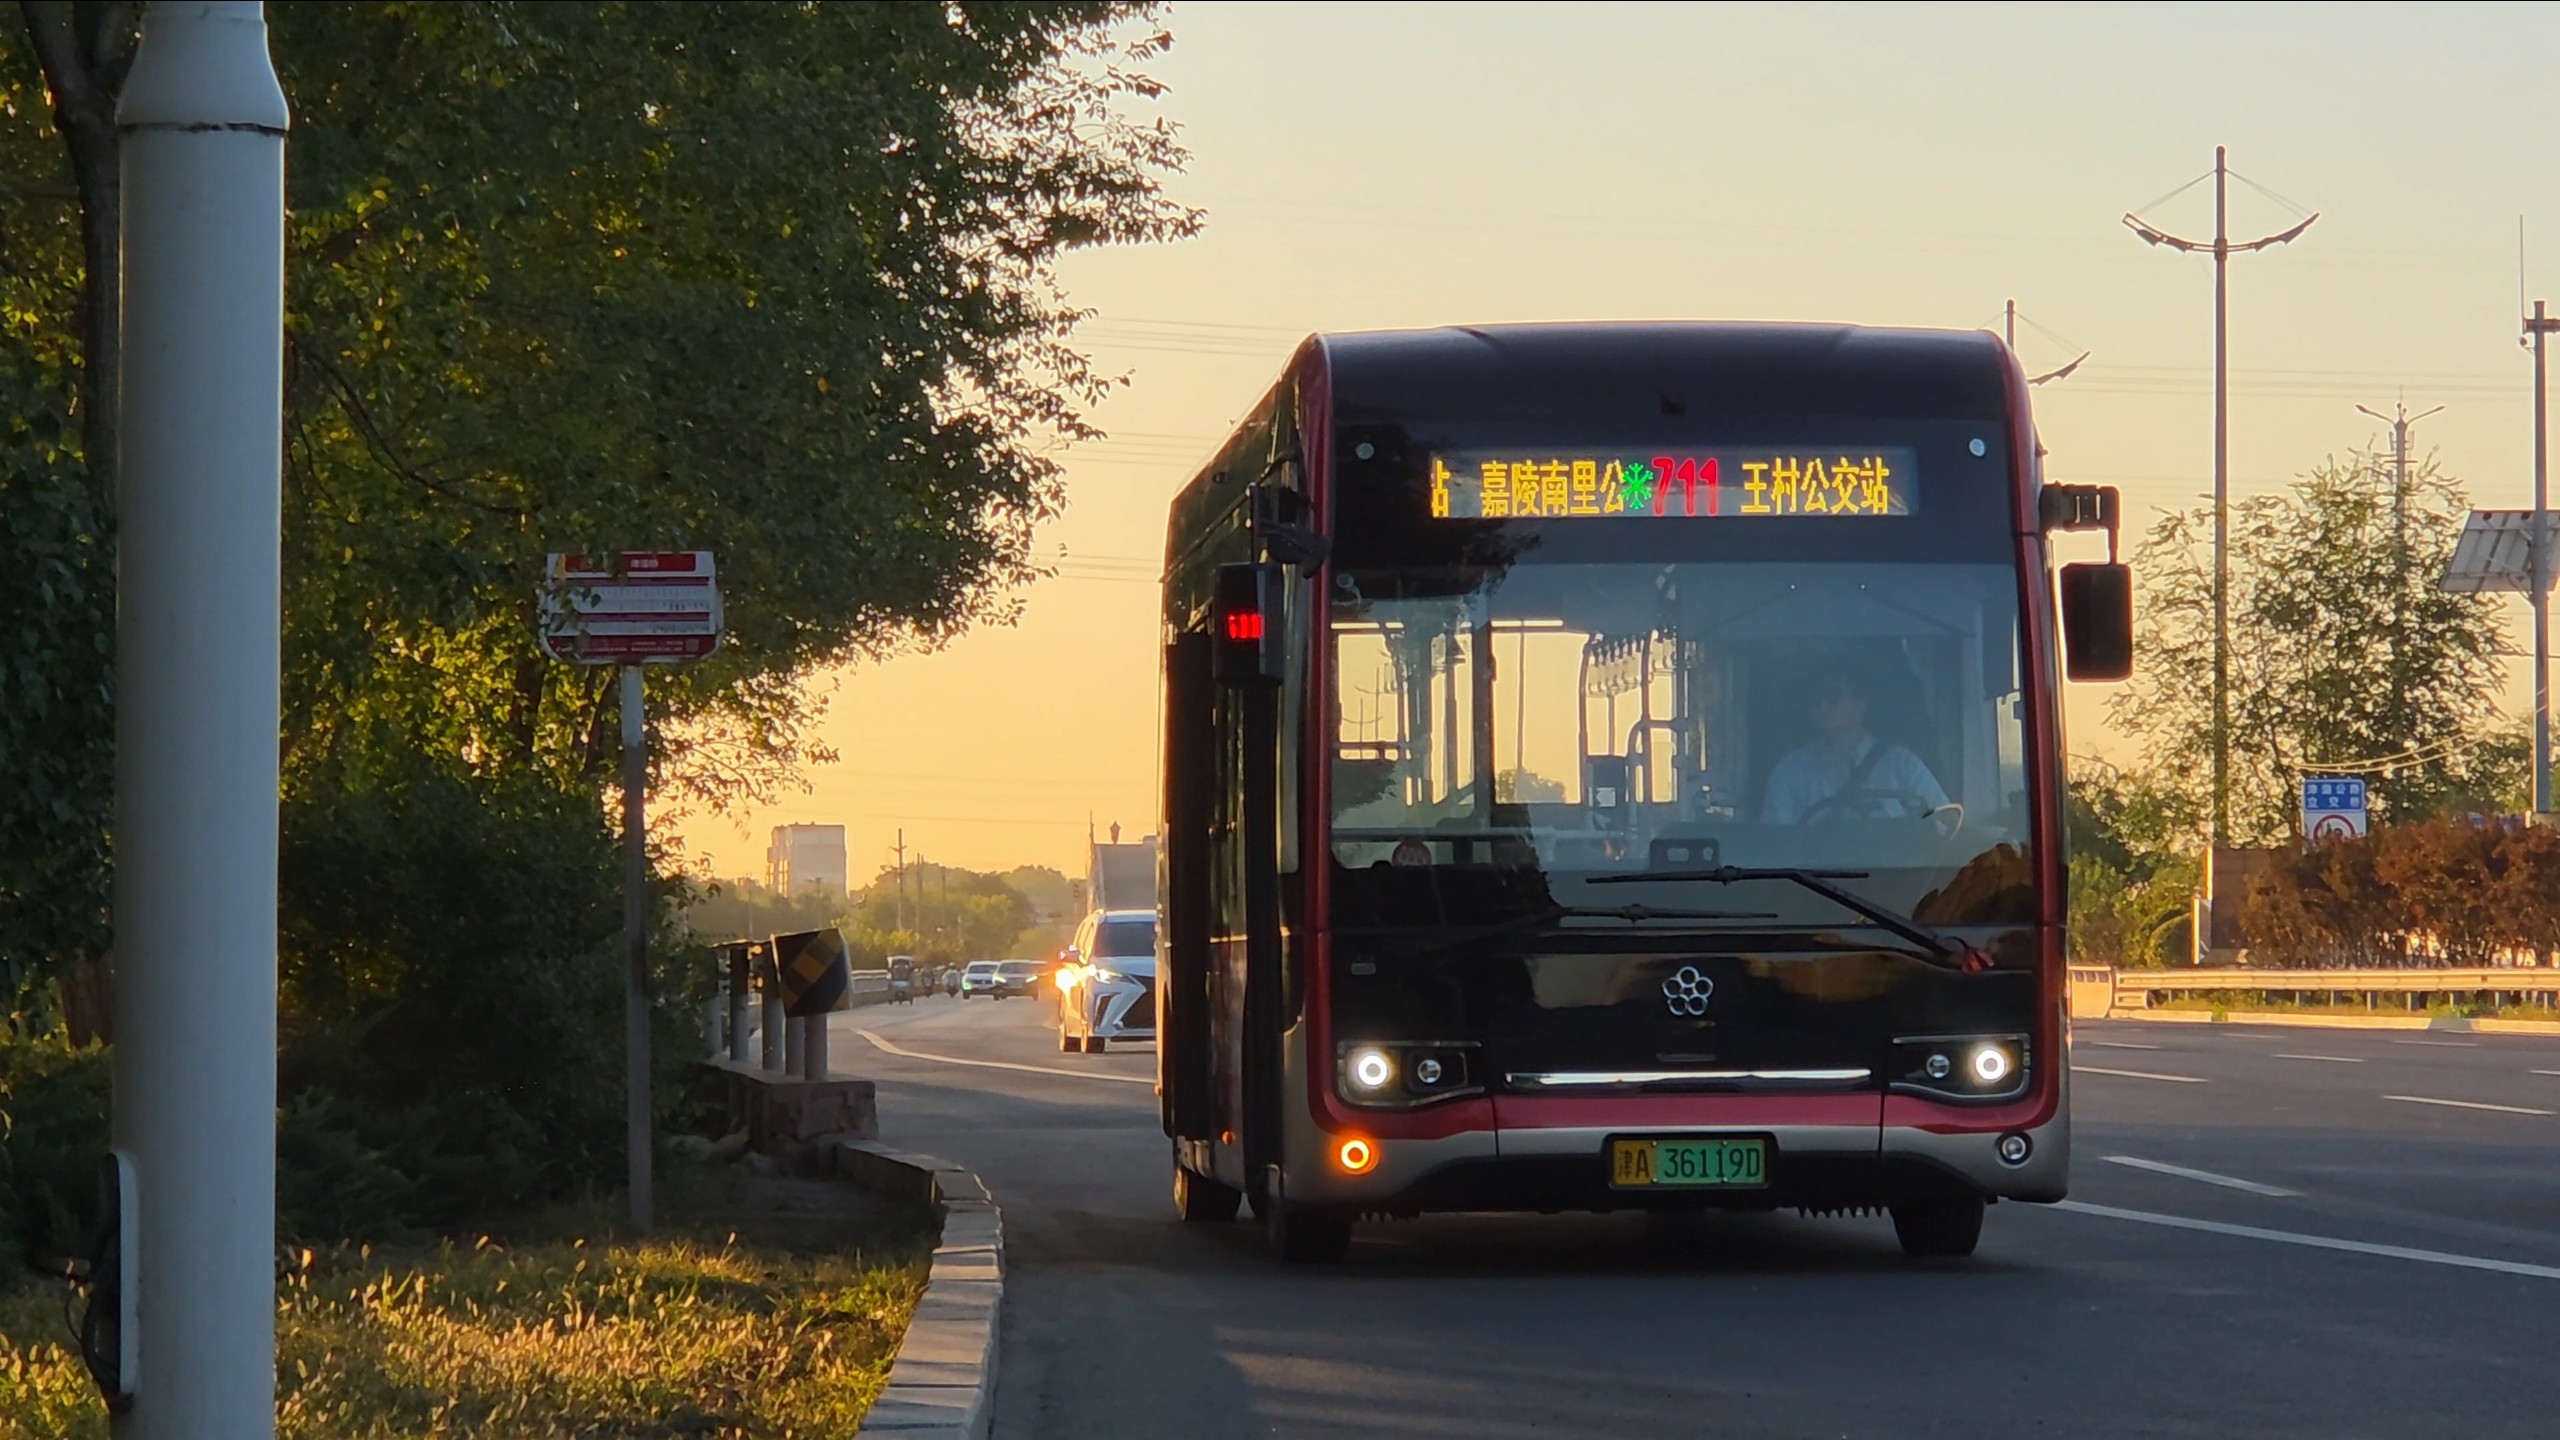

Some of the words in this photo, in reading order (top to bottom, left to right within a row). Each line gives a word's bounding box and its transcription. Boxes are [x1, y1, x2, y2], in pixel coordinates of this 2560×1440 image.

[1480, 459, 1623, 517] 嘉陵南里公
[1651, 457, 1718, 517] 711
[1740, 457, 1890, 515] 王村公交站
